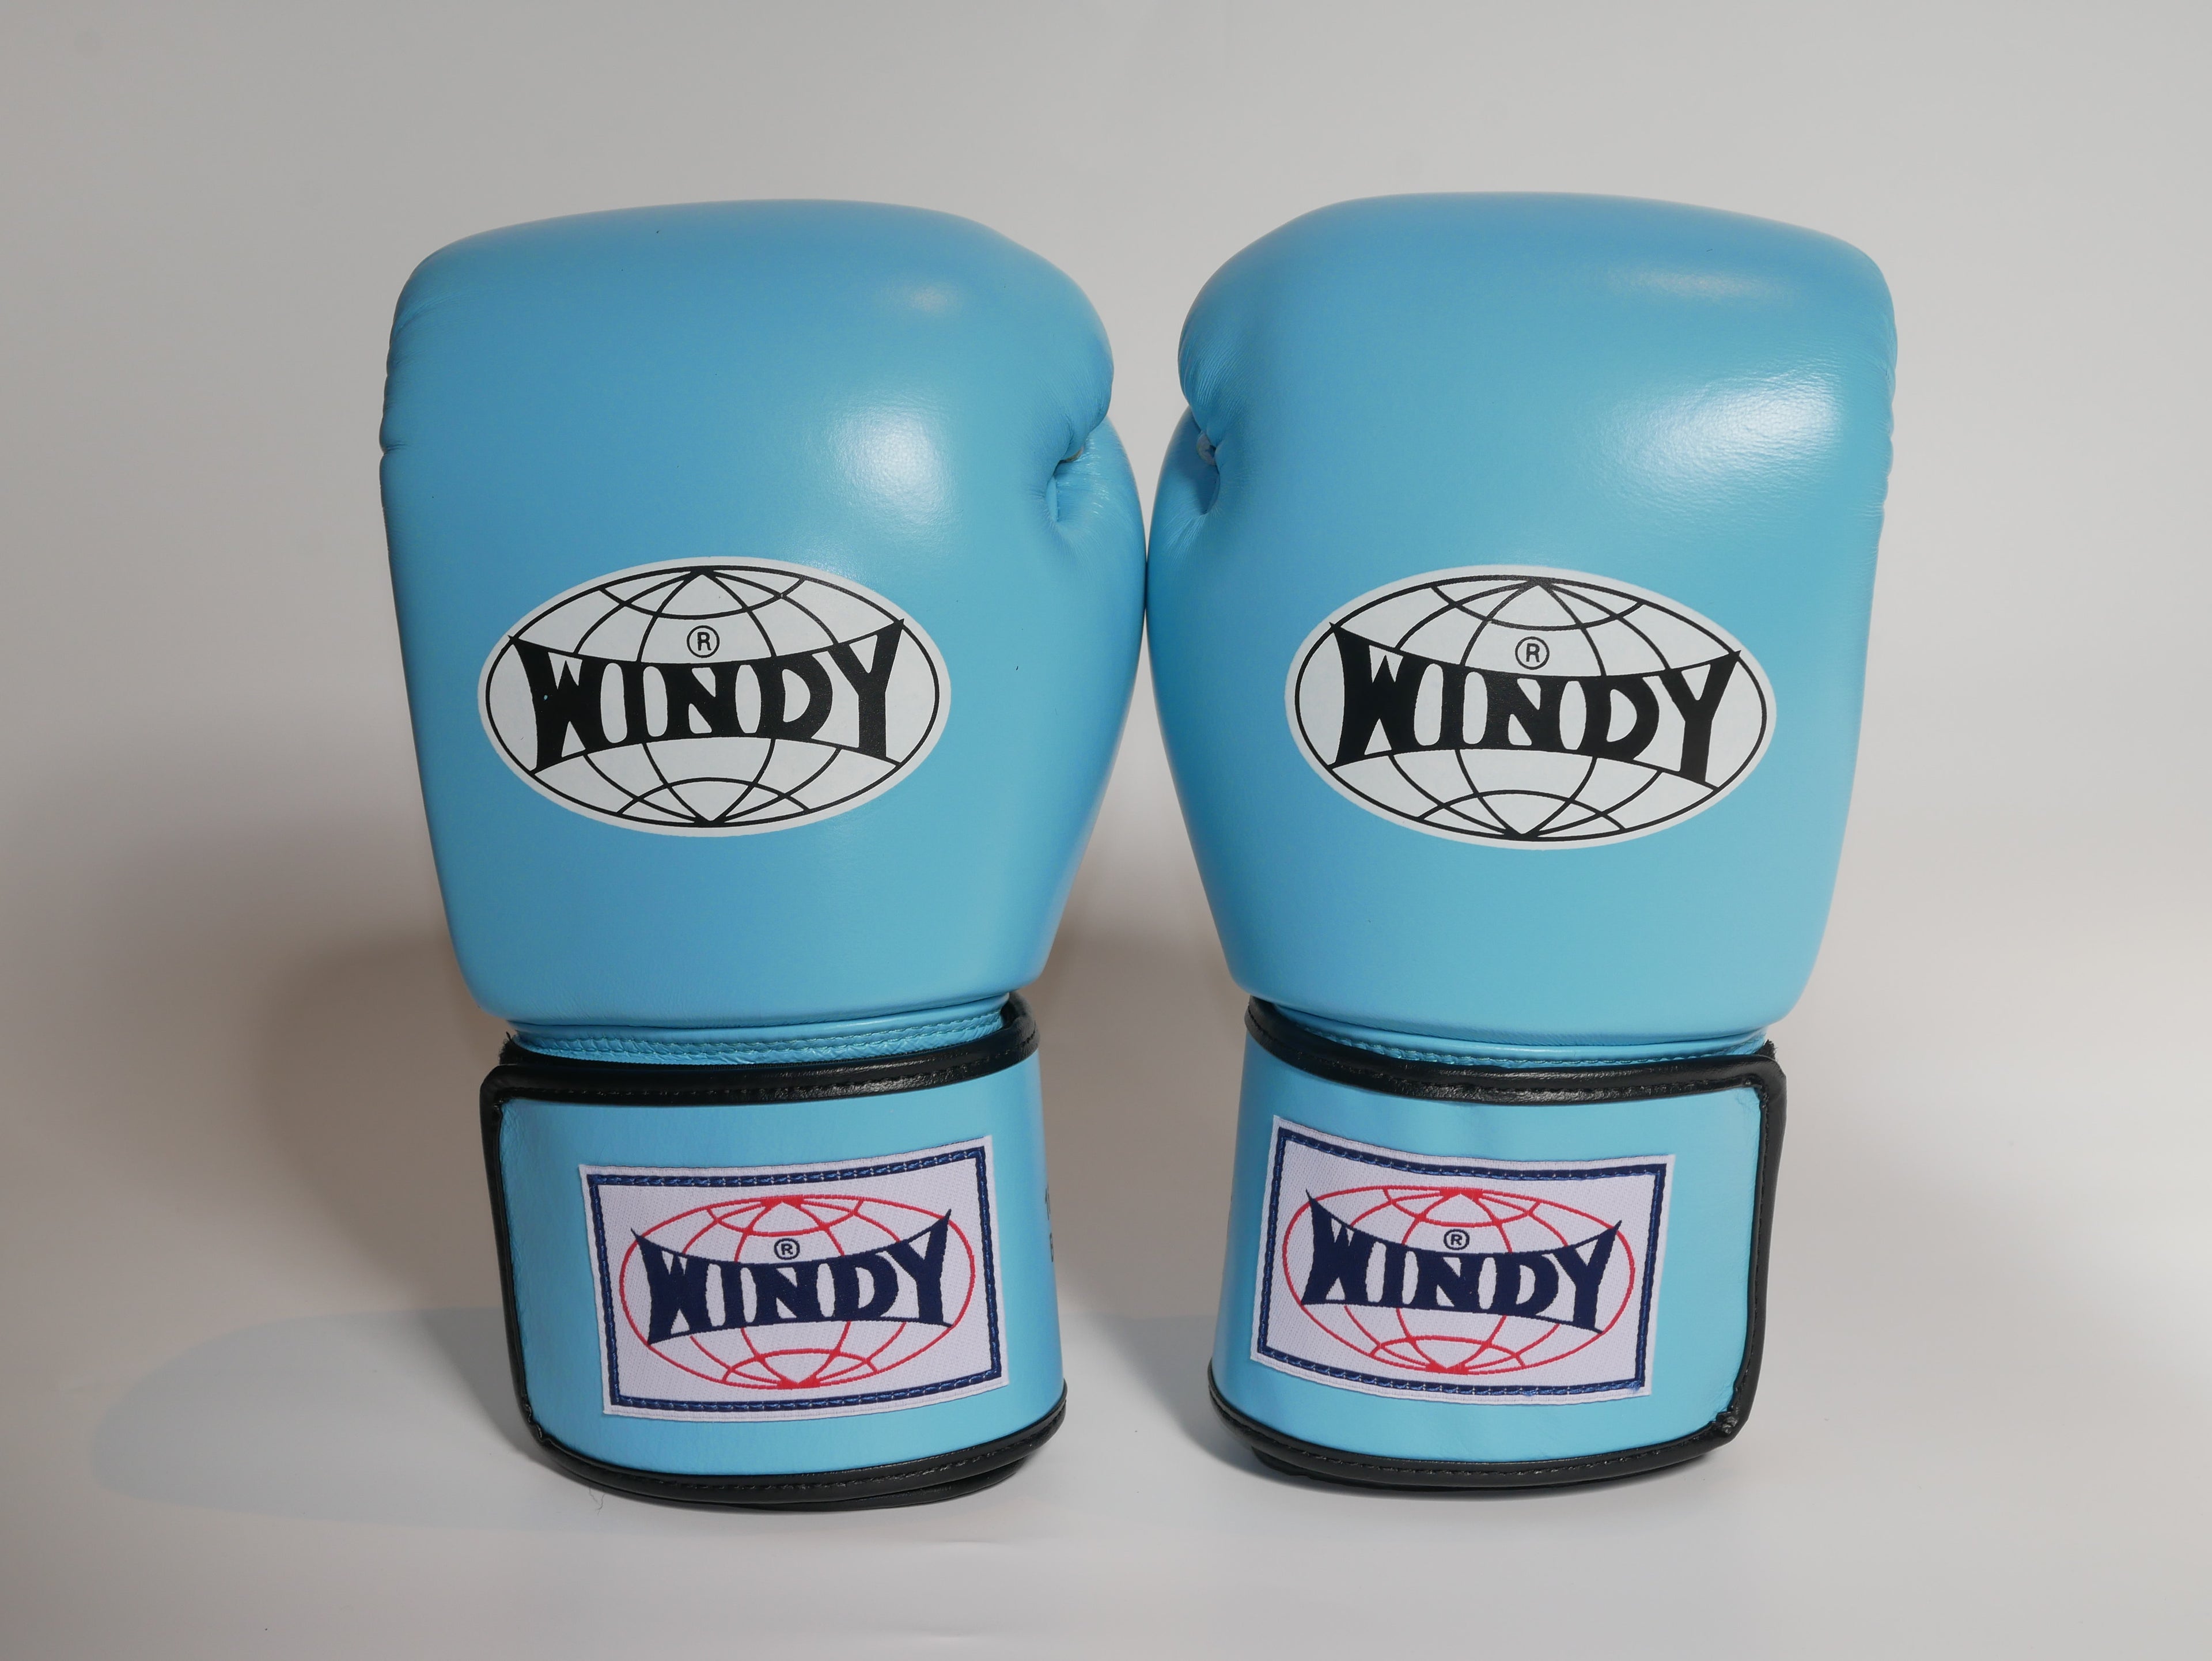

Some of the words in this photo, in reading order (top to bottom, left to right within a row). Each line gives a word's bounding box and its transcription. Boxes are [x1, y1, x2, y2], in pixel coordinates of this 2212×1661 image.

[509, 618, 904, 774] WINDY
[1330, 623, 1740, 790] WINDY
[630, 1209, 953, 1345] WINDY
[1301, 1190, 1622, 1334] WINDY
